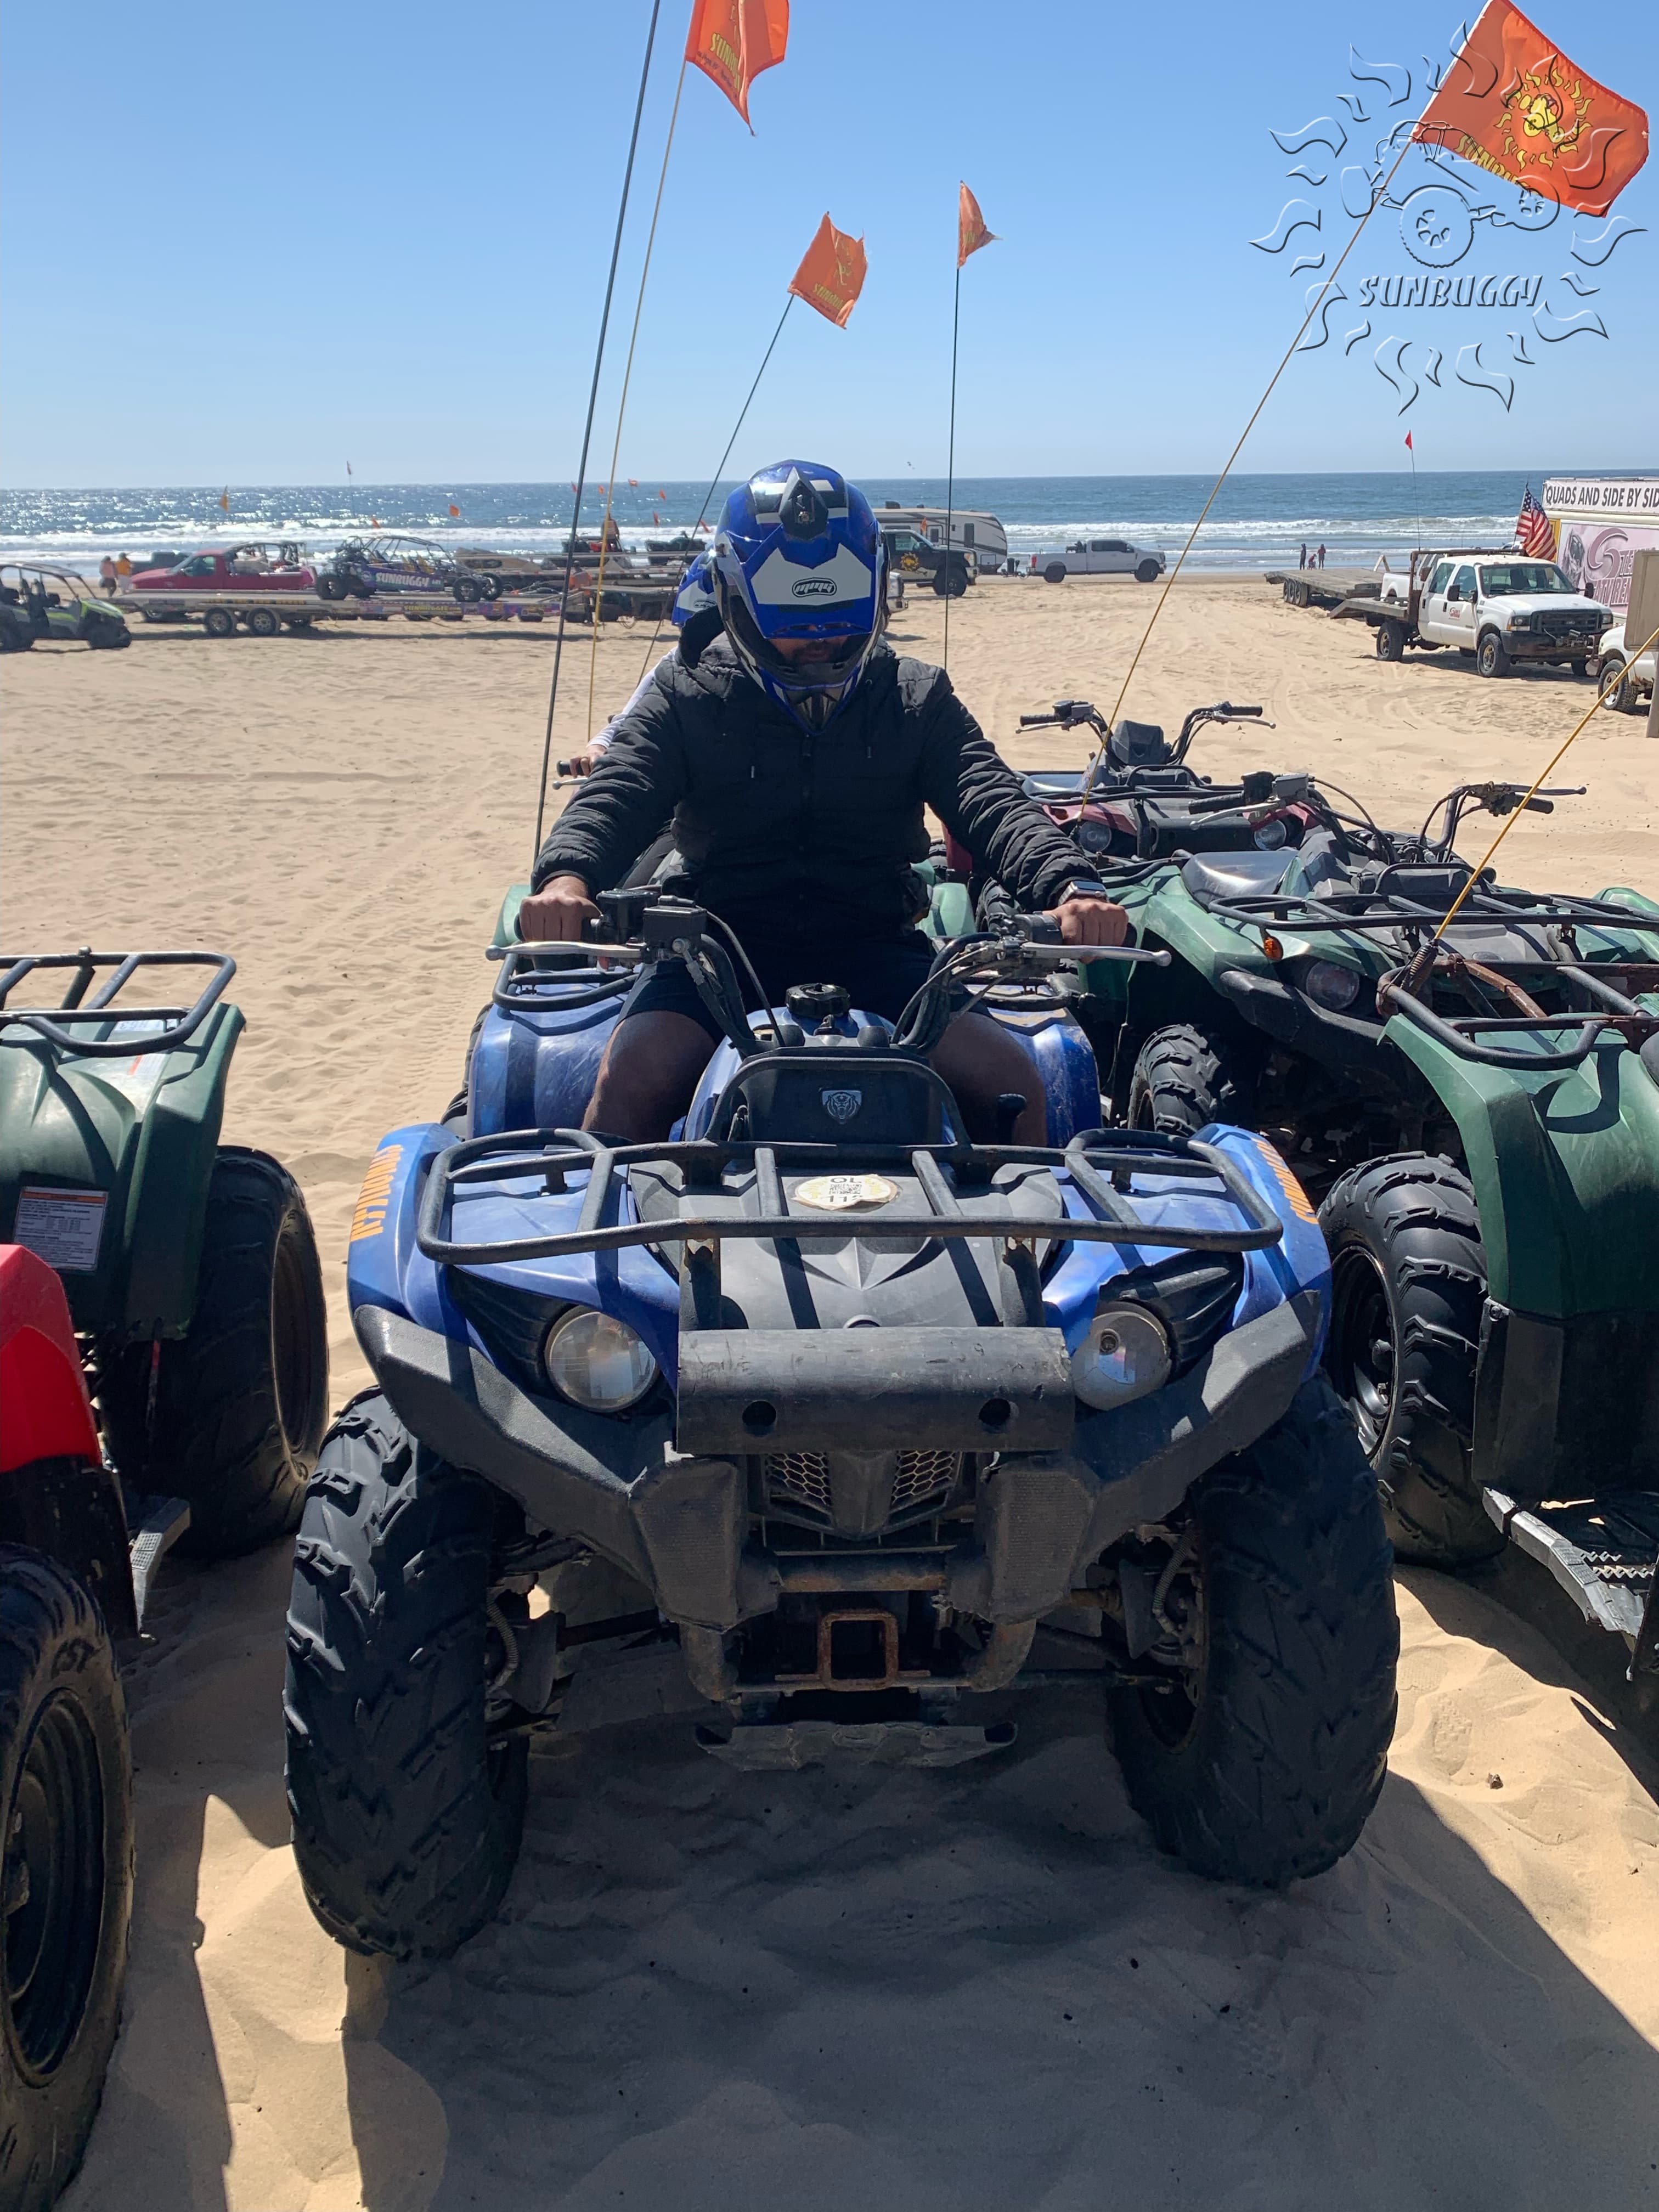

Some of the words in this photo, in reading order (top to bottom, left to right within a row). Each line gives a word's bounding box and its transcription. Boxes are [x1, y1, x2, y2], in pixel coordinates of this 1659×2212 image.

[1545, 487, 1577, 505] QUADS
[1578, 487, 1600, 506] AND
[1601, 487, 1624, 507] SIDE
[1626, 488, 1641, 508] BY
